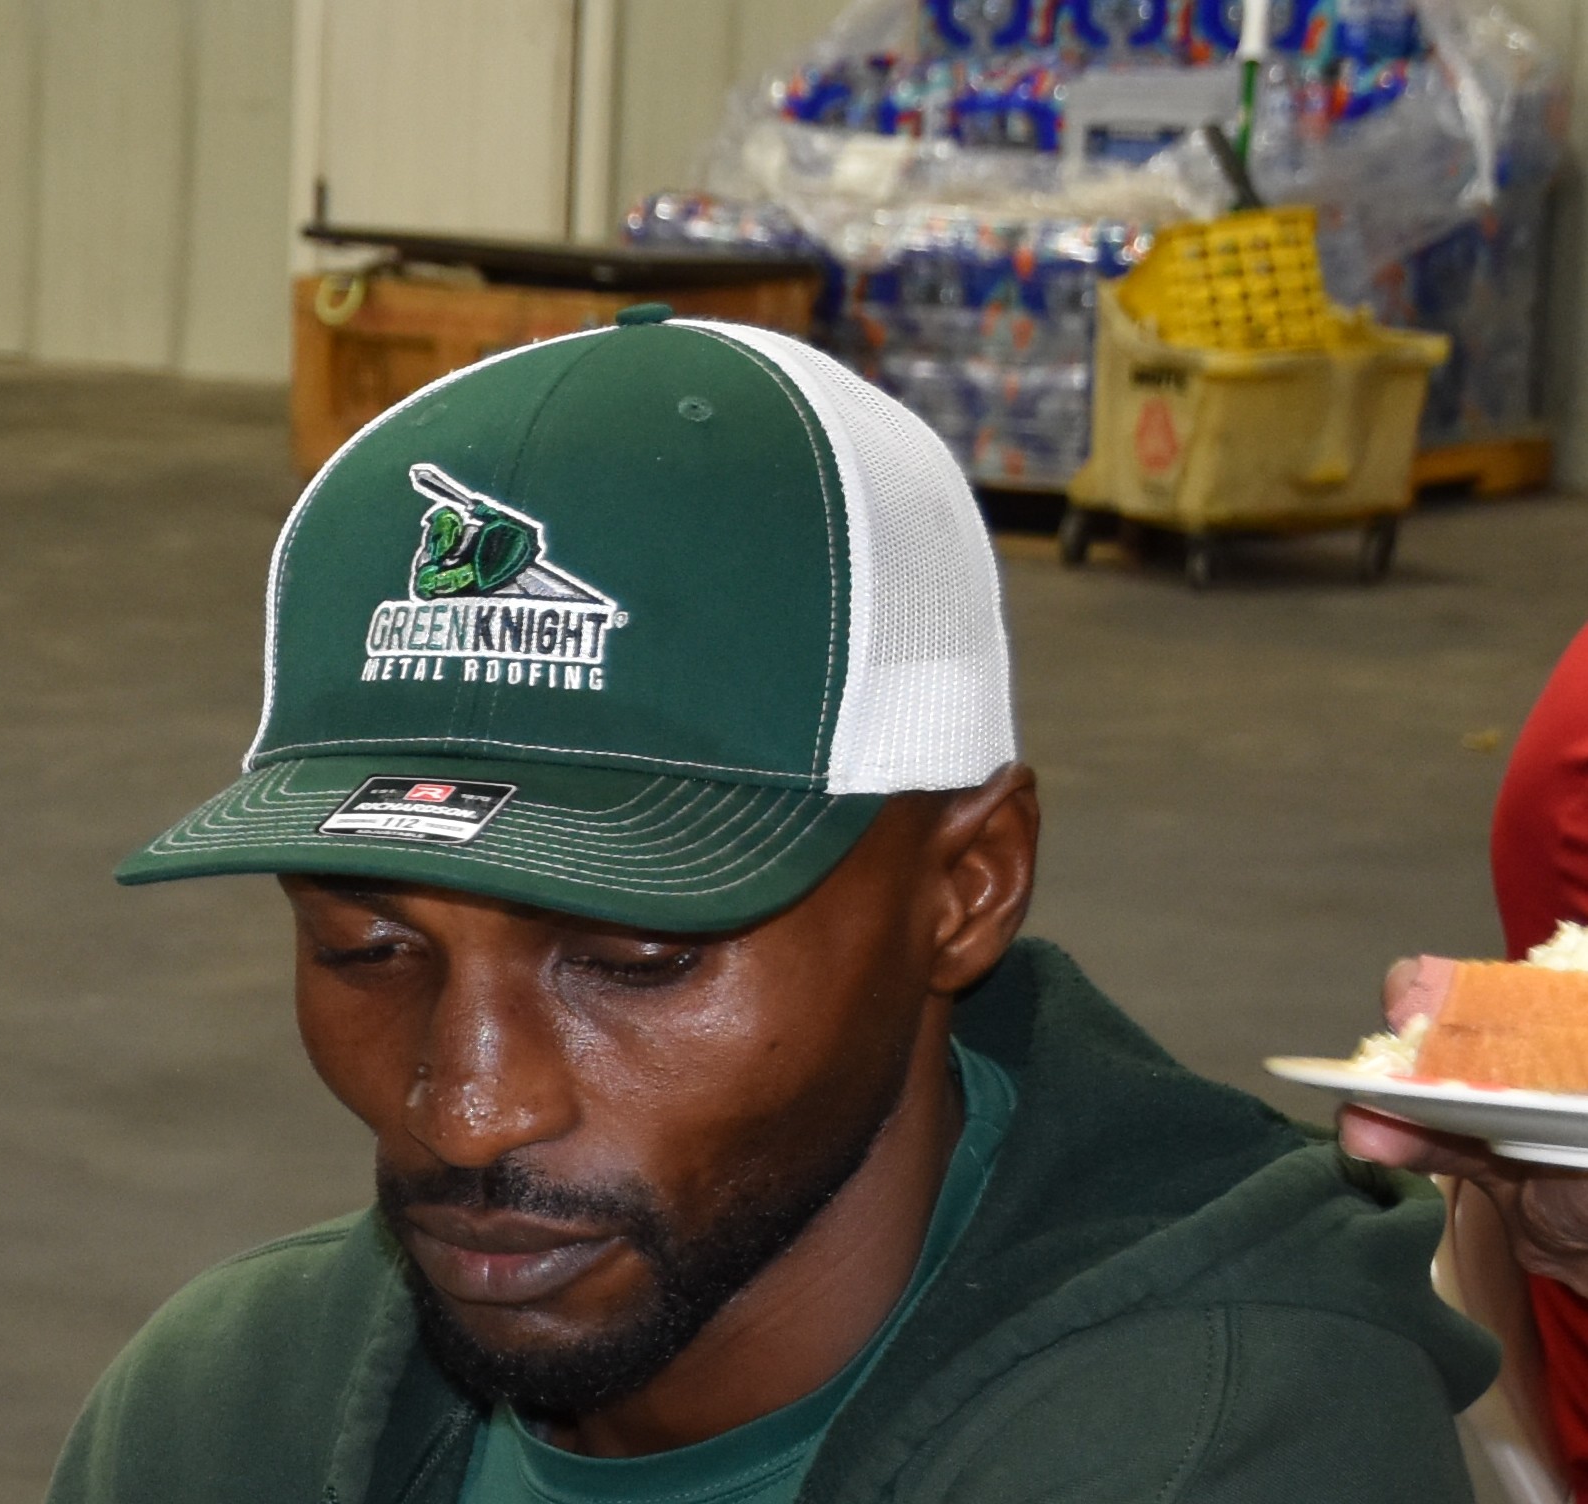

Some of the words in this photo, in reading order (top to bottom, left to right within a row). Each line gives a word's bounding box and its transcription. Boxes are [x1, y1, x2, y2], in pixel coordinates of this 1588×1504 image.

[361, 658, 445, 682] METAL
[463, 659, 604, 690] ROOFING
[353, 802, 476, 819] RICHARDSON
[382, 816, 420, 829] 112
